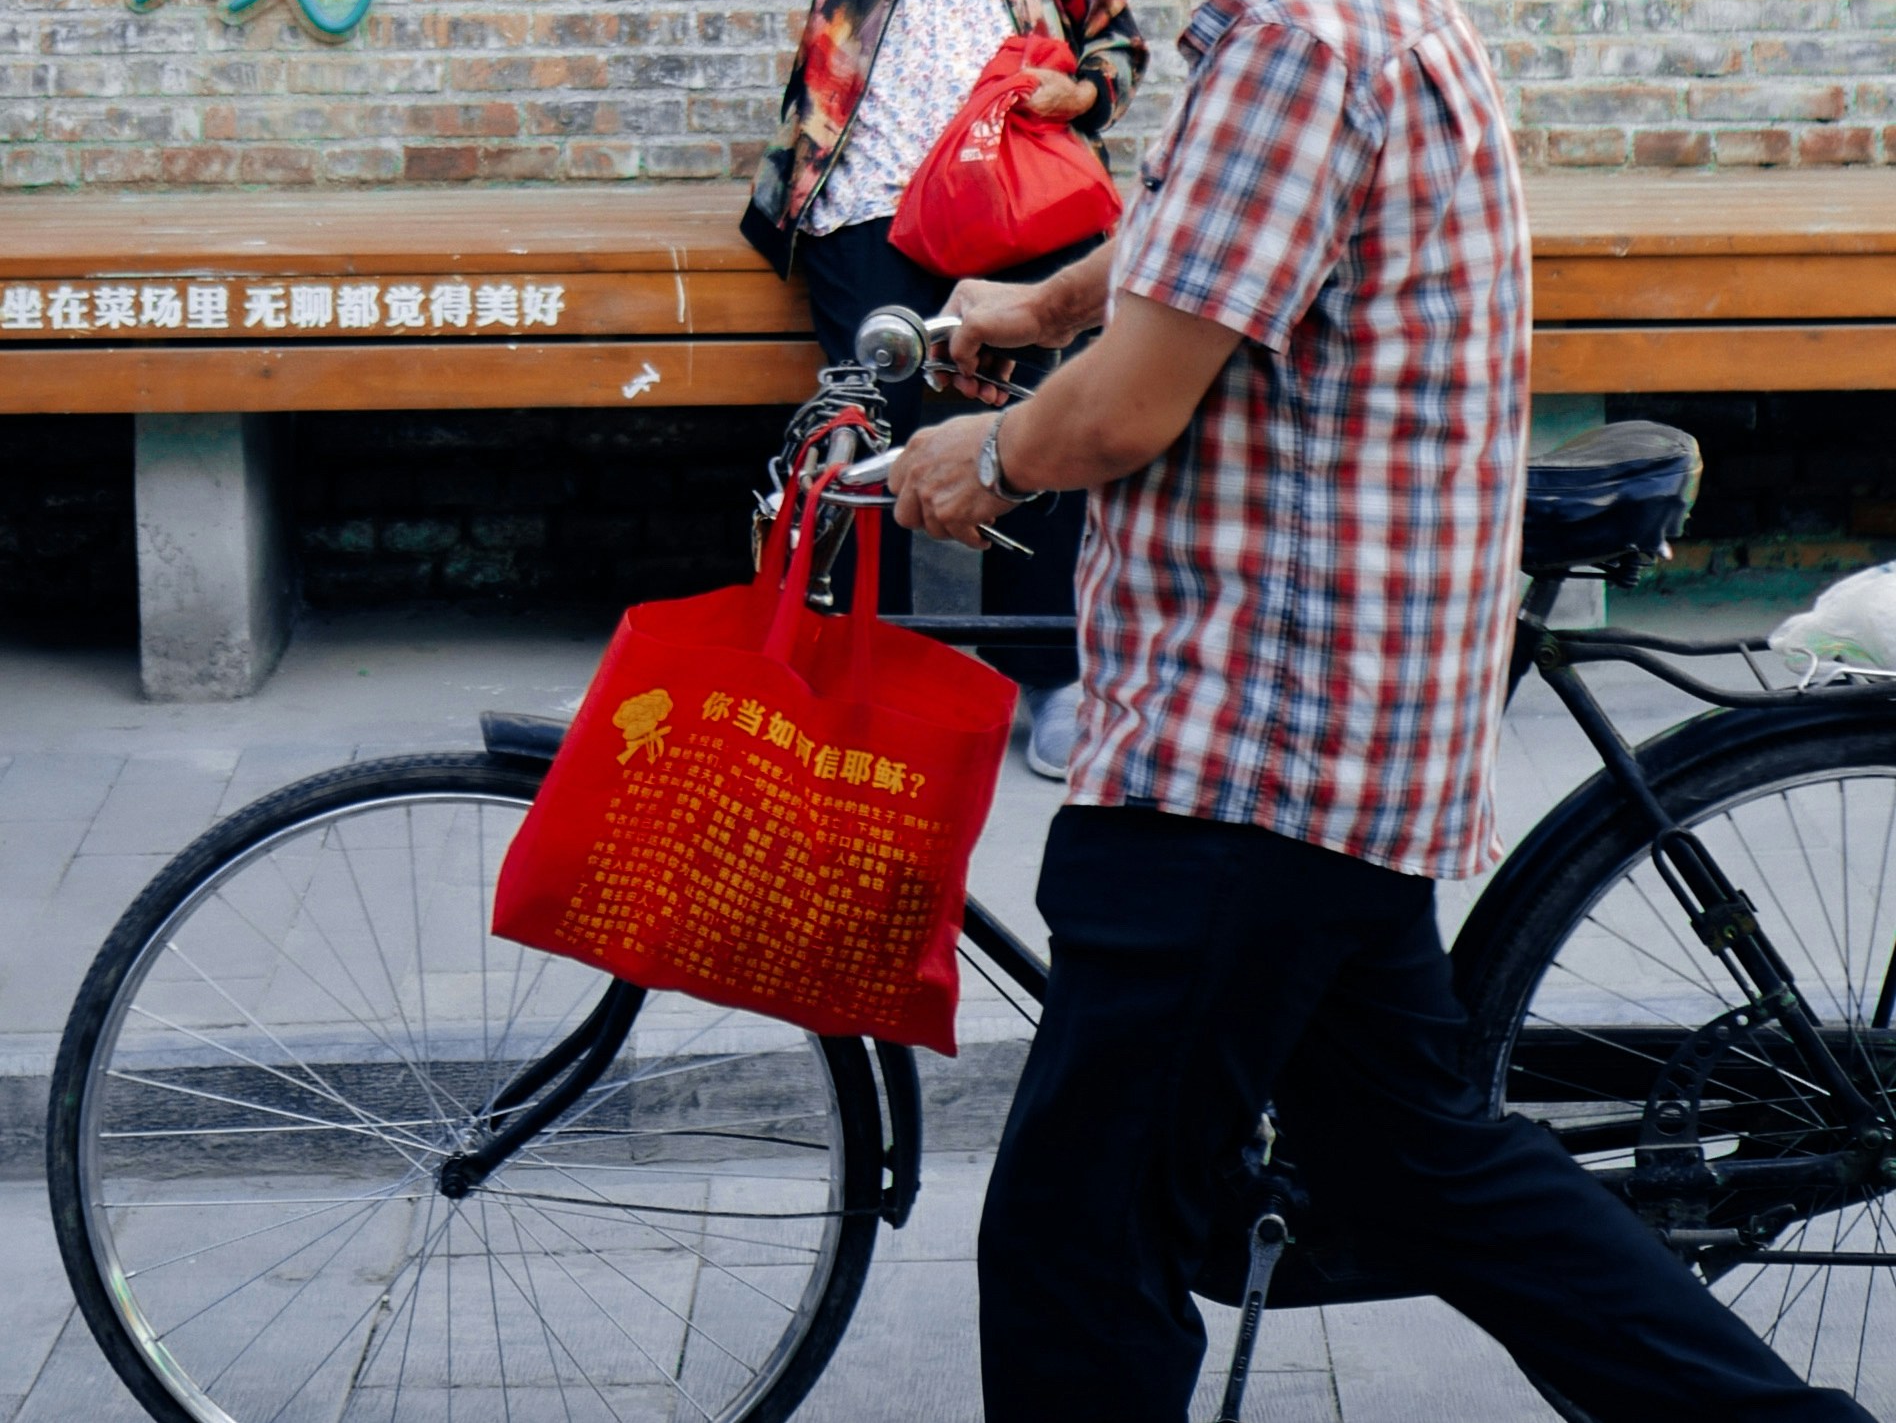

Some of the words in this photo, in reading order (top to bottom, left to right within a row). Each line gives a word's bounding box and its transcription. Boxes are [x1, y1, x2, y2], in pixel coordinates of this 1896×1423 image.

[1, 285, 229, 329] 坐在菜场里
[244, 284, 565, 329] 无聊都觉得美好
